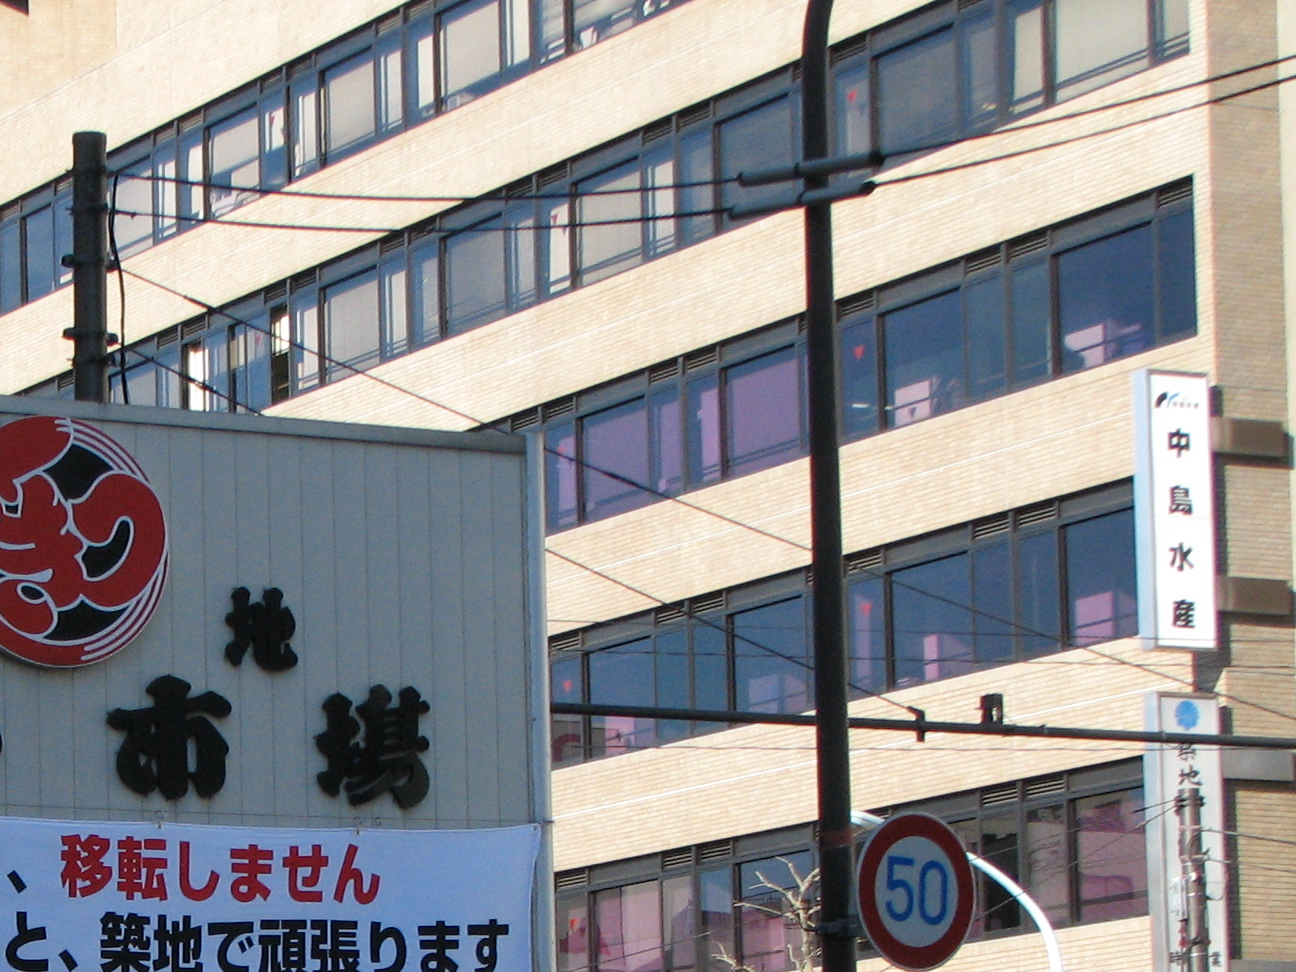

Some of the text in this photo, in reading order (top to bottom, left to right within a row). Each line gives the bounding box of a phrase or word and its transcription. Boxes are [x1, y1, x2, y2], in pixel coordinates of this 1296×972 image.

[1168, 427, 1196, 630] 中島水産
[885, 855, 949, 926] 50
